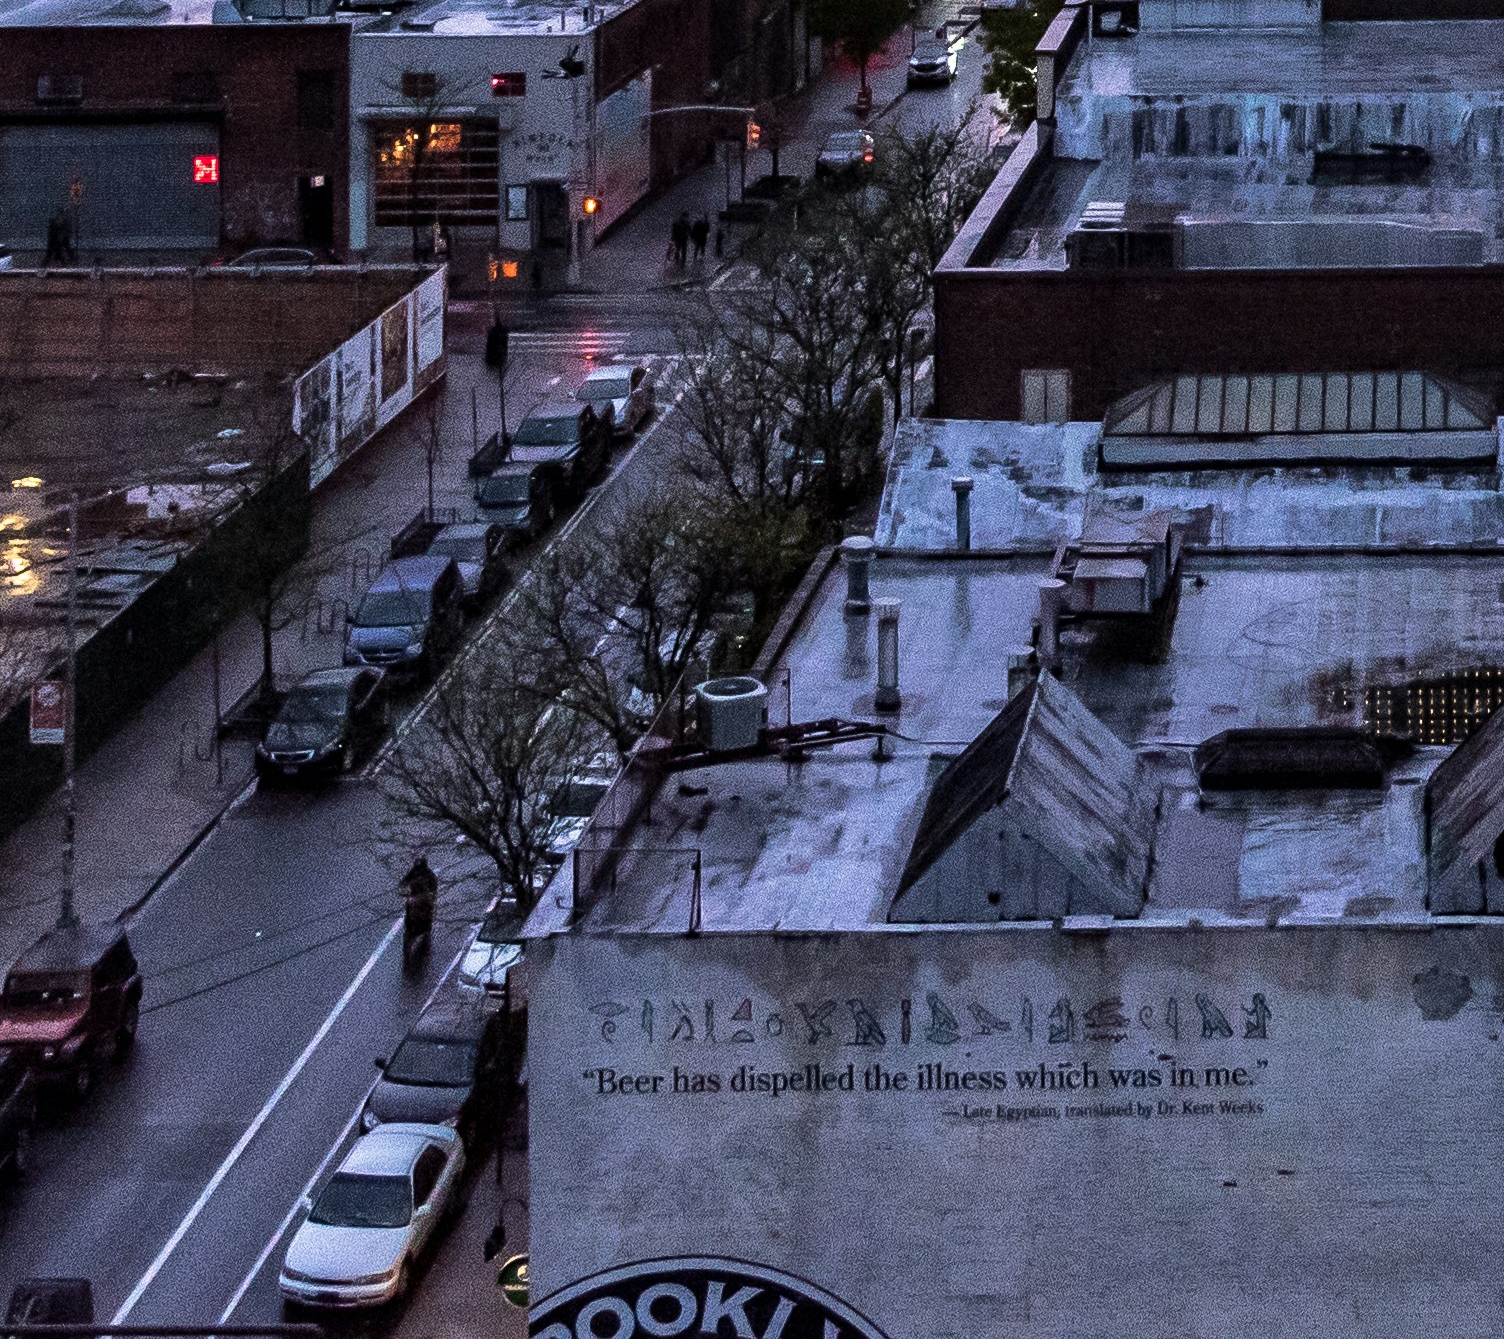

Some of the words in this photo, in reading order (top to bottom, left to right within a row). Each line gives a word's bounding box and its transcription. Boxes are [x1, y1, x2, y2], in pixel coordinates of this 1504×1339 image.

[674, 1067, 721, 1092] has
[731, 1064, 854, 1097] dispelled
[865, 1065, 907, 1091] the
[917, 1063, 1006, 1090] illness
[1016, 1062, 1099, 1089] which
[1108, 1066, 1163, 1087] was
[1171, 1060, 1195, 1087] in
[963, 1105, 992, 1118] Late
[996, 1104, 1060, 1121] Egyptian,
[1065, 1104, 1133, 1118] translated
[1137, 1103, 1153, 1120] by
[1157, 1102, 1178, 1116] Dr.
[1182, 1101, 1214, 1115] Kent
[1219, 1101, 1264, 1115] Weeks
